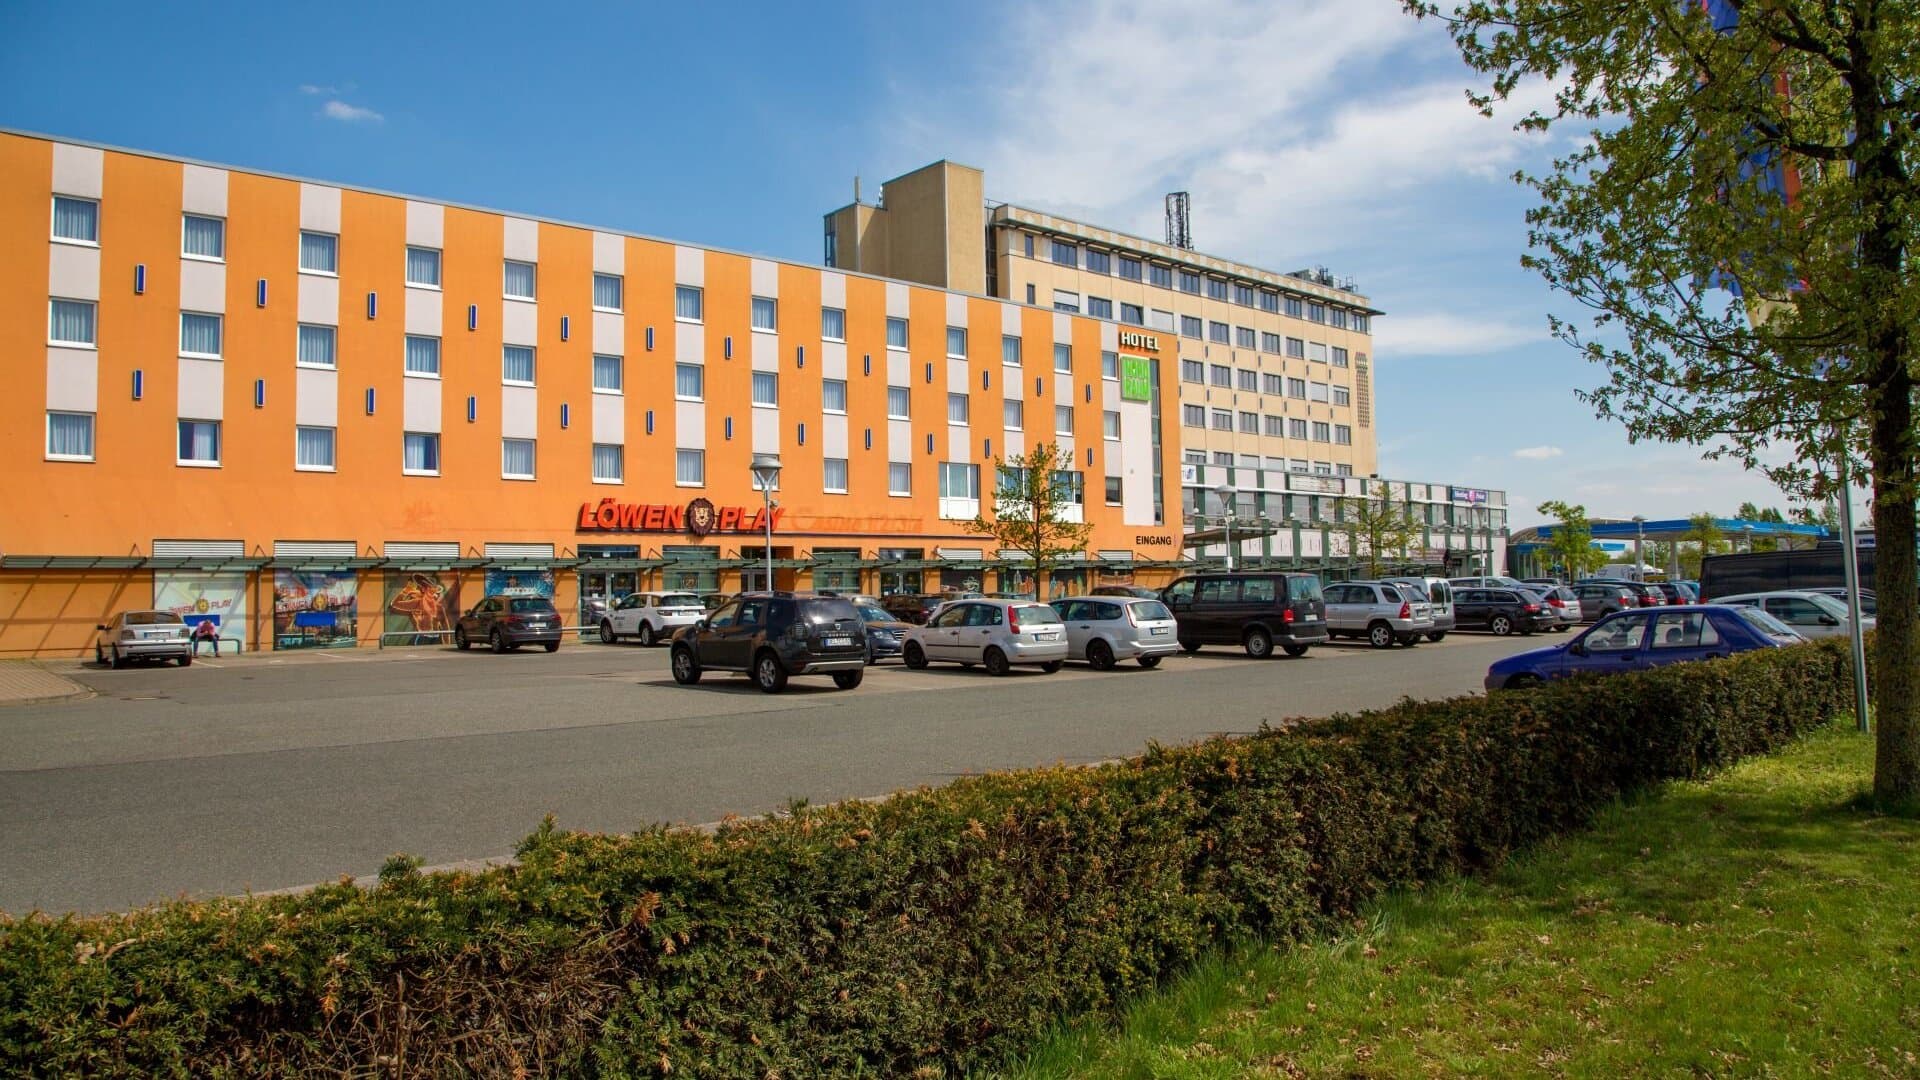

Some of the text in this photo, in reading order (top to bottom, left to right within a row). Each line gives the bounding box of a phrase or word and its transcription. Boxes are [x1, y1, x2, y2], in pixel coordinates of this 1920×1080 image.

[1120, 332, 1160, 351] HOTEL
[579, 497, 684, 529] LÖWEN
[719, 506, 786, 531] PLAY
[1135, 535, 1172, 546] EINGANG
